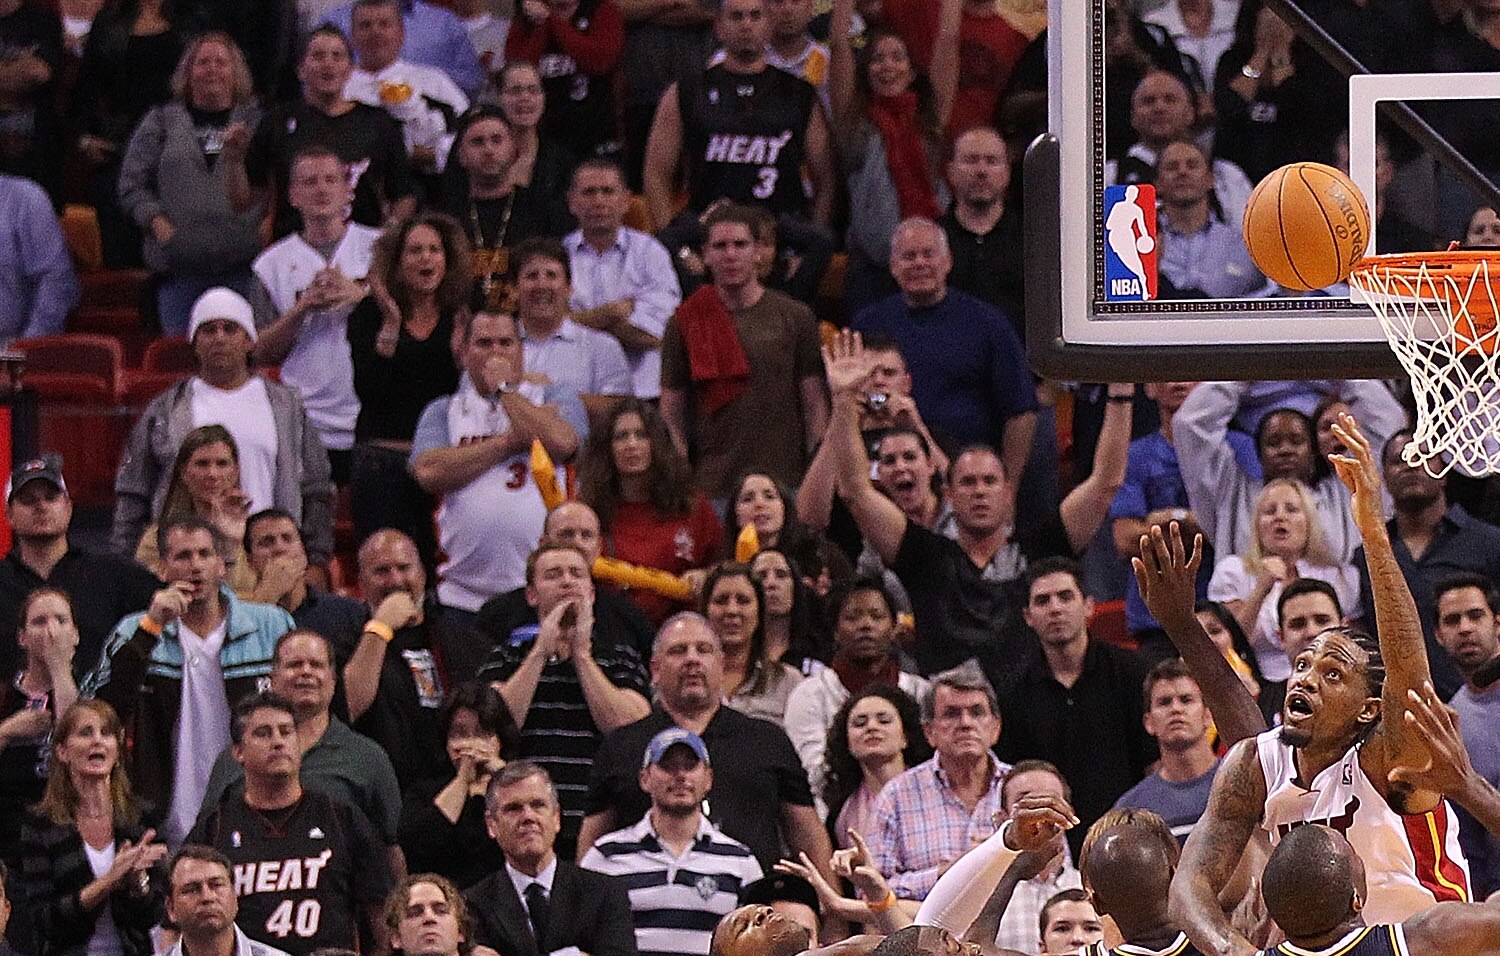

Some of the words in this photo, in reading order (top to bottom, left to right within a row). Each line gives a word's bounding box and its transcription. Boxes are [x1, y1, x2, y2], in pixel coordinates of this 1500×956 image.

[704, 130, 794, 165] HEAT
[751, 166, 780, 200] 3
[1111, 278, 1141, 296] NBA
[505, 460, 528, 490] 3
[232, 848, 333, 898] HEAT
[264, 899, 321, 938] 40
